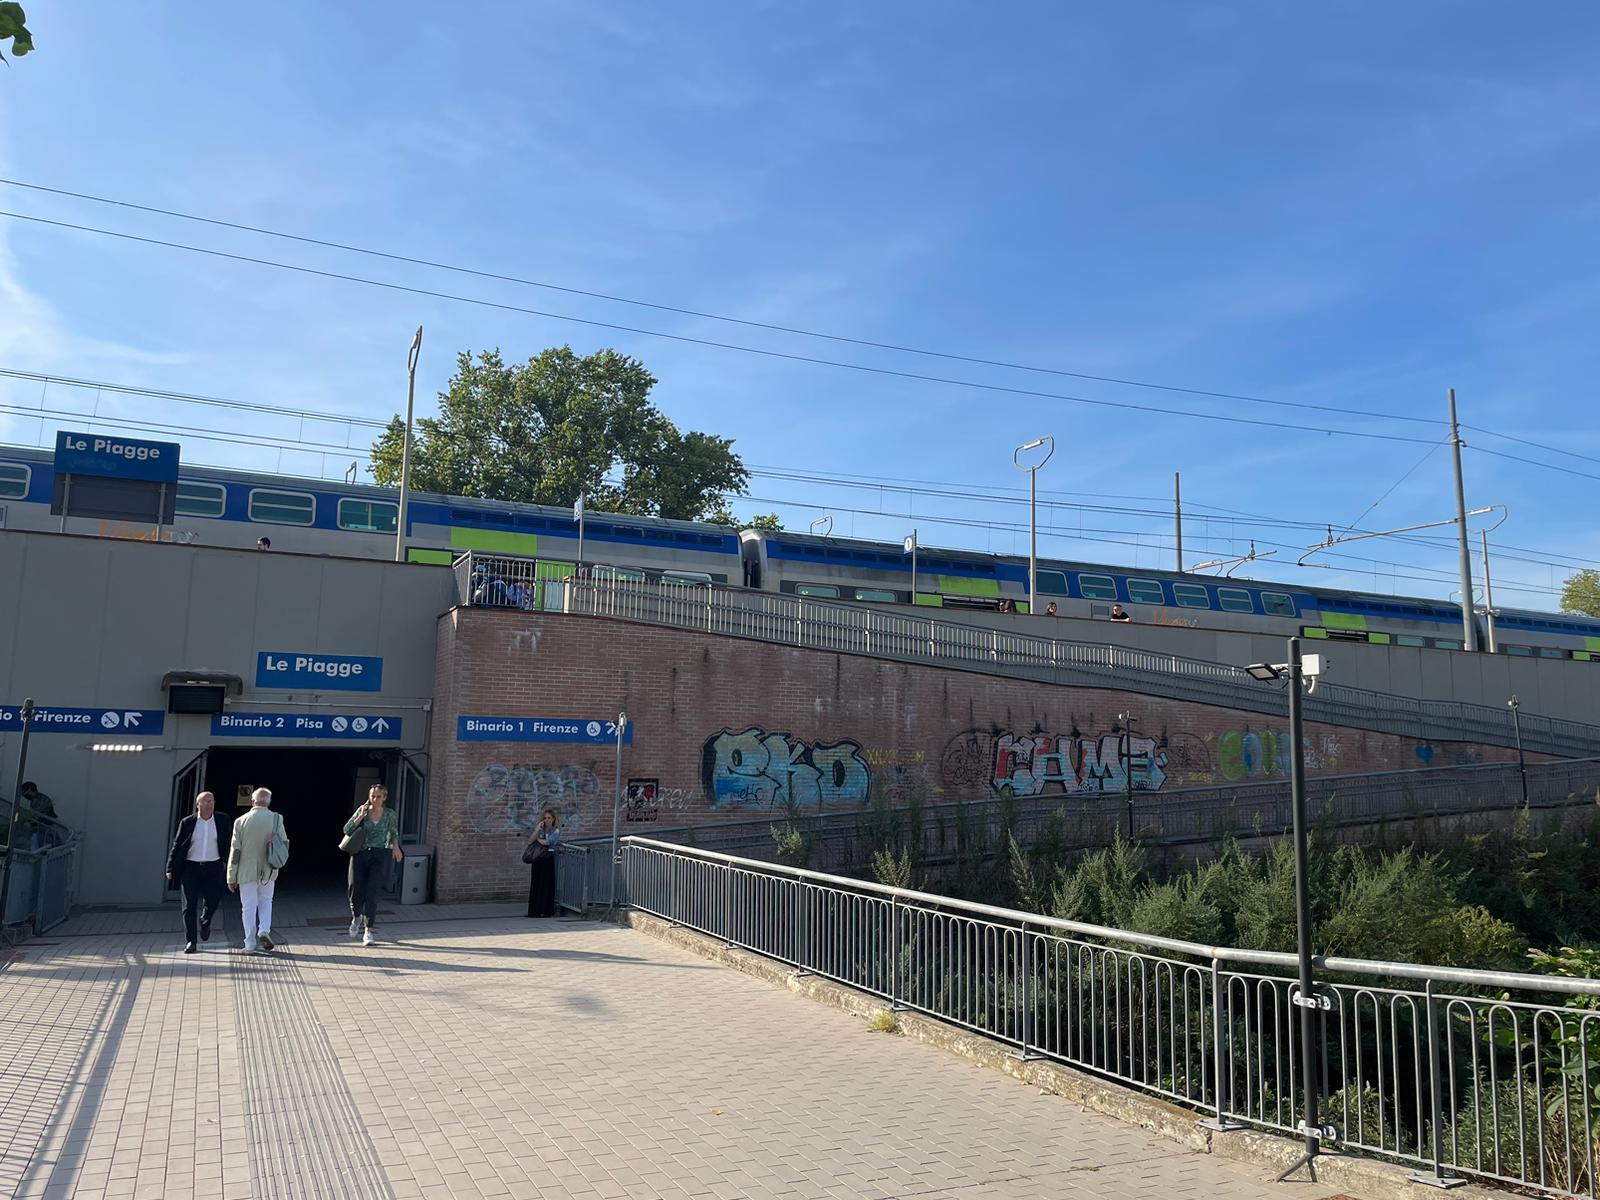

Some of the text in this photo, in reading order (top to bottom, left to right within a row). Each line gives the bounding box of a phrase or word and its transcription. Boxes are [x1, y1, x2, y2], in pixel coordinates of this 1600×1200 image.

[65, 436, 160, 460] Le Piagge
[266, 656, 363, 677] Le Piagge
[220, 715, 324, 729] Binario 2 Pisa
[466, 720, 579, 734] Binario 1 Firenze
